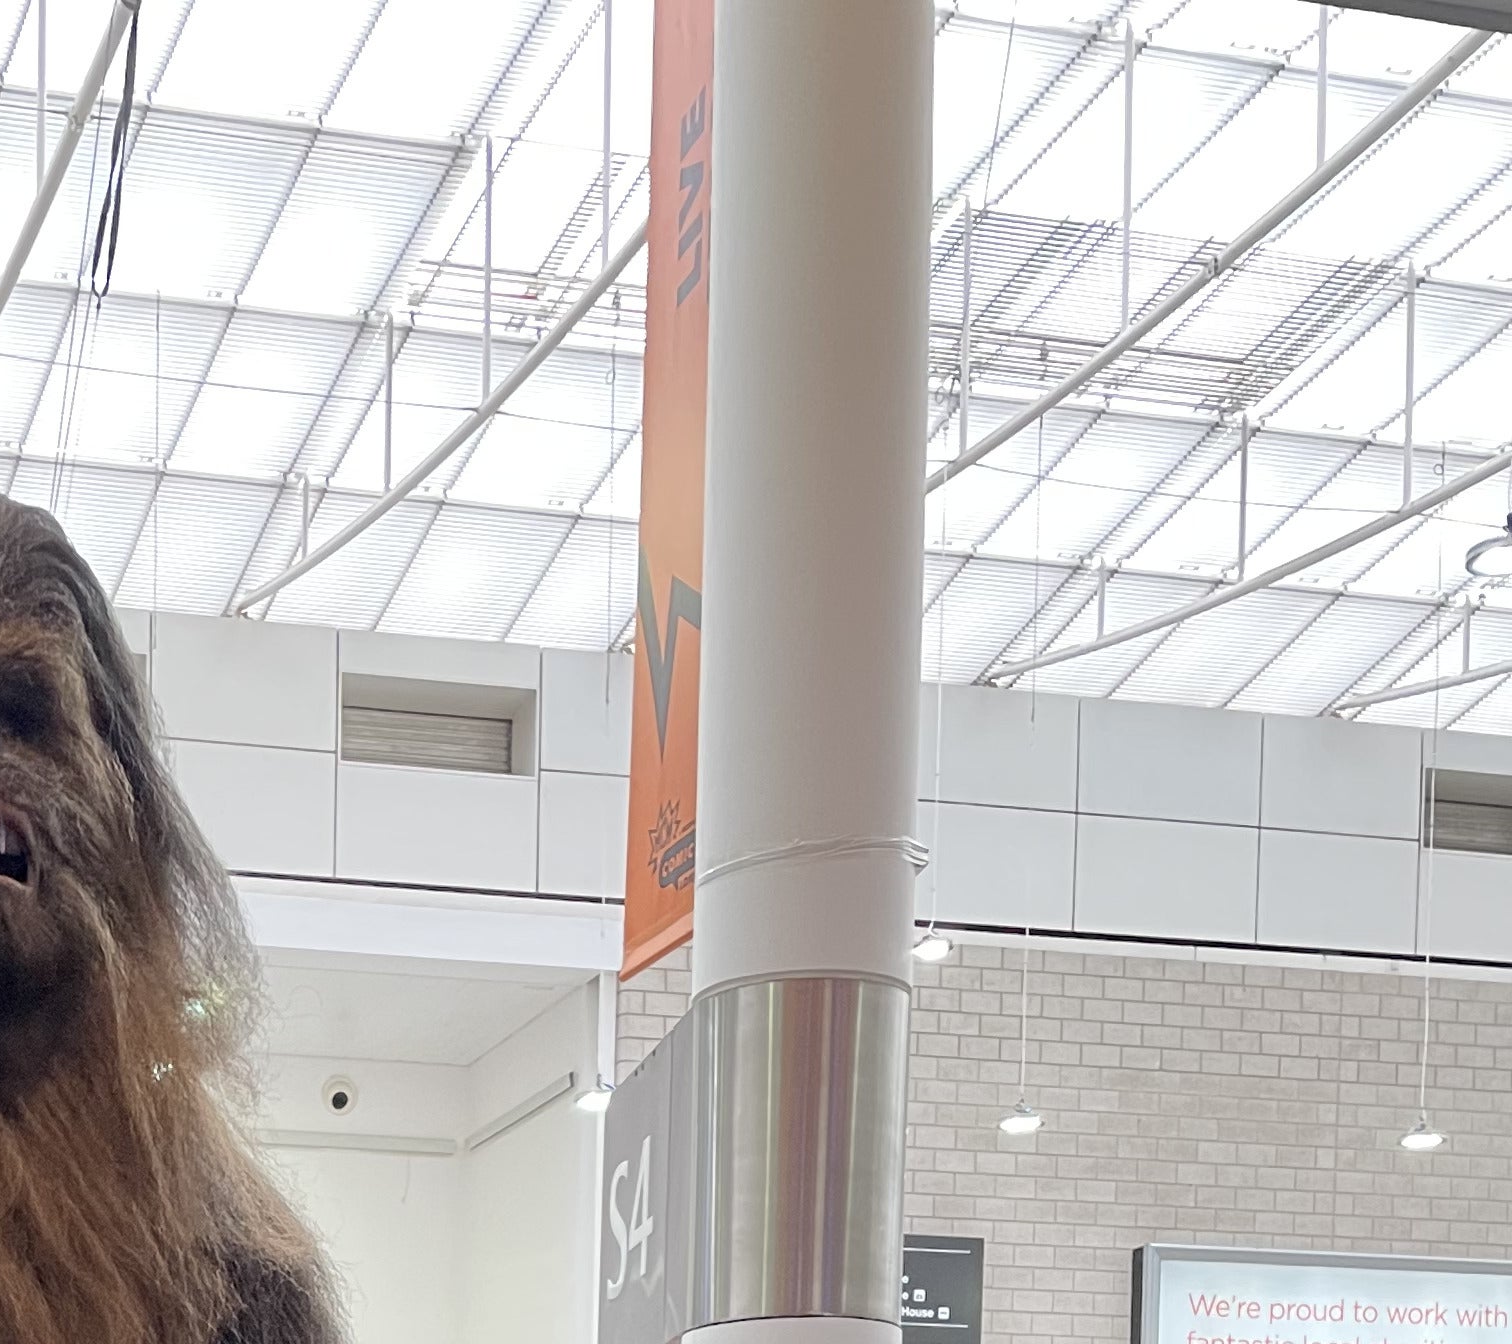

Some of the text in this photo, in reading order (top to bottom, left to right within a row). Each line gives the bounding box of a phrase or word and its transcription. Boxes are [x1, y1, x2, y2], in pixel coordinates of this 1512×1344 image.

[677, 84, 706, 309] LINE
[607, 1135, 653, 1300] S4
[902, 1307, 935, 1318] House
[1188, 1293, 1508, 1328] We're proud to work with
